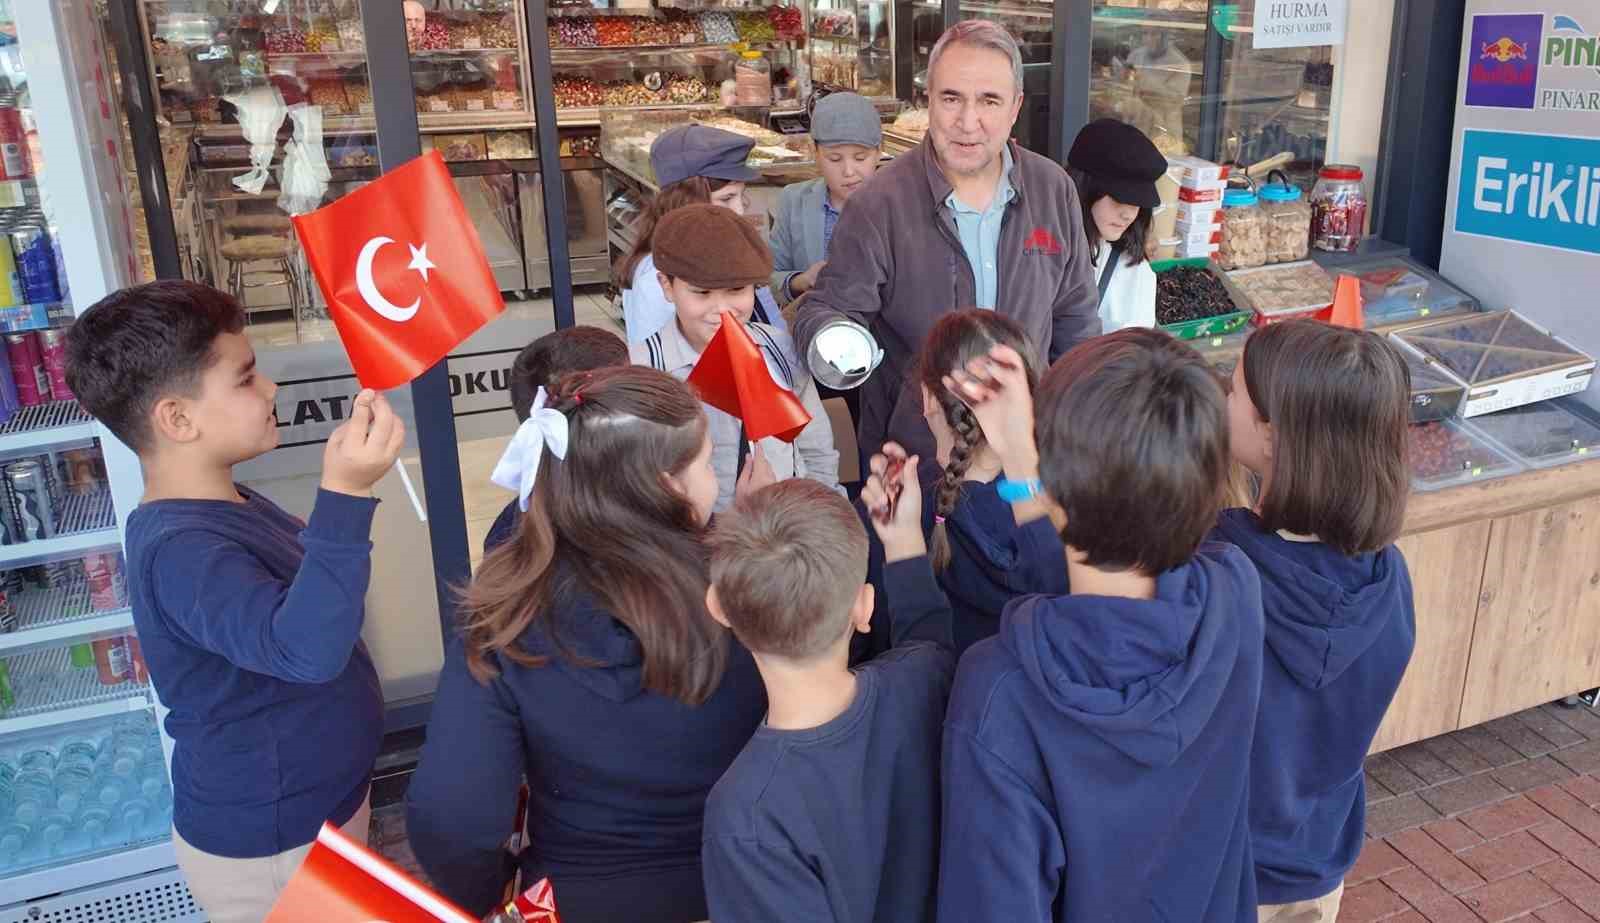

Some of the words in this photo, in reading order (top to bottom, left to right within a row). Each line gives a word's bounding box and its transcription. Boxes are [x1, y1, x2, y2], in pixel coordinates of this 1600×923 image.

[1270, 2, 1328, 19] HURMA
[1544, 37, 1600, 67] PIN
[1473, 155, 1600, 227] Erikli
[272, 394, 357, 427] LAT
